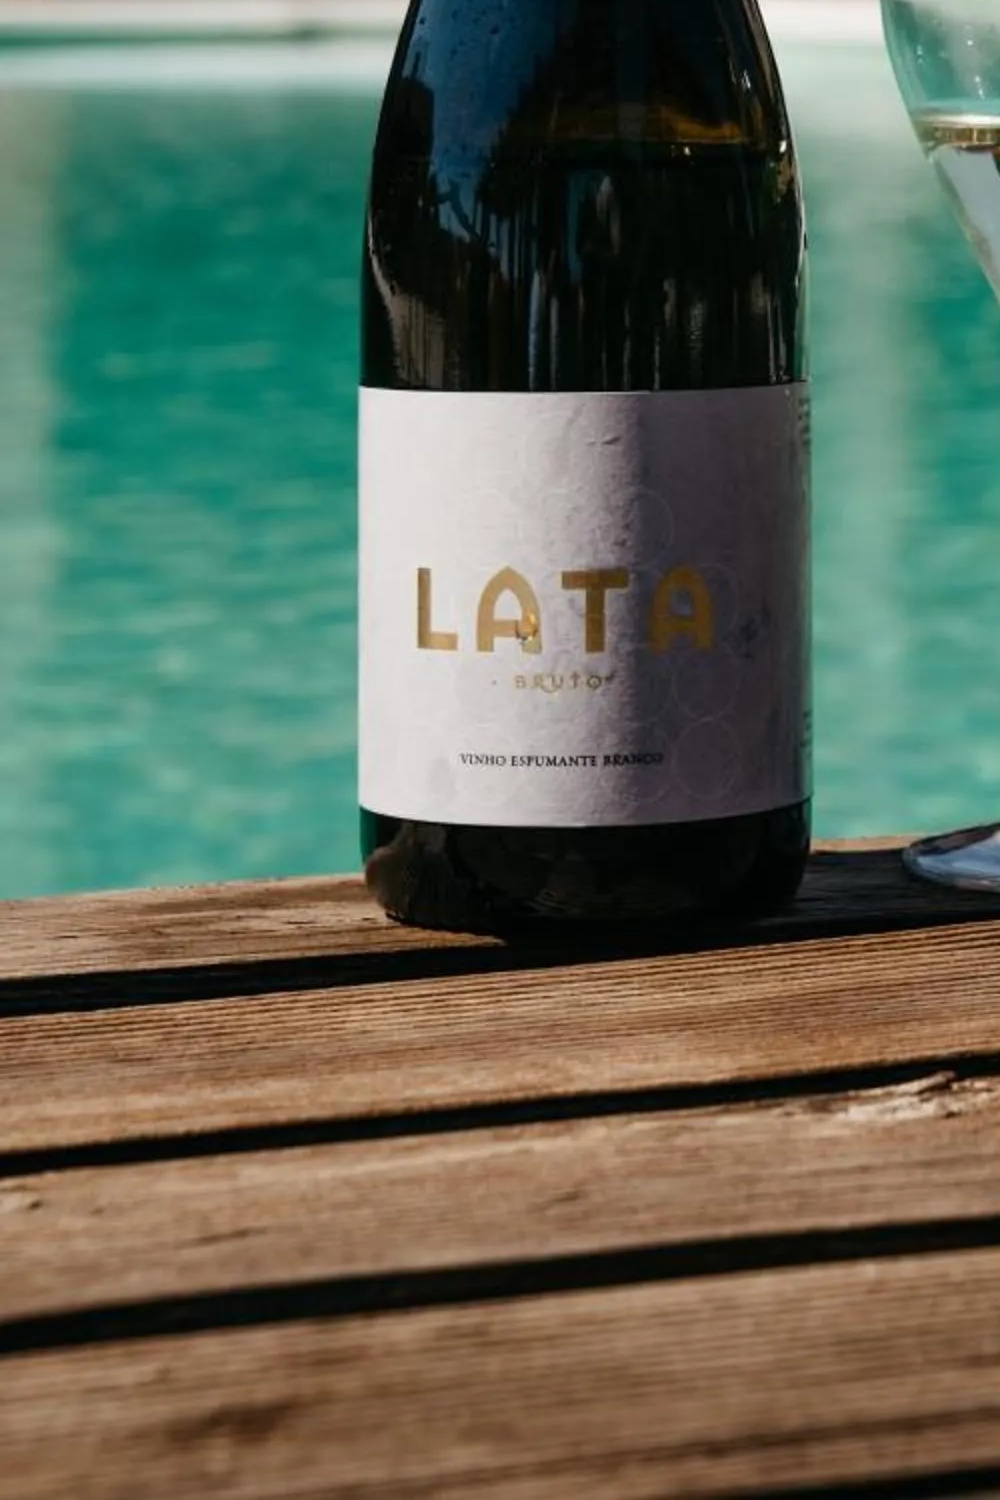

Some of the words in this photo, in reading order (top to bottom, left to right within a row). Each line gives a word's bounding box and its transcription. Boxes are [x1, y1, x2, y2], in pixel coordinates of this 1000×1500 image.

[417, 566, 715, 654] LATA
[514, 672, 603, 693] BRUTO
[460, 752, 507, 767] VINHO
[510, 754, 599, 768] ESPUMANTE
[602, 752, 665, 768] BRANCO
